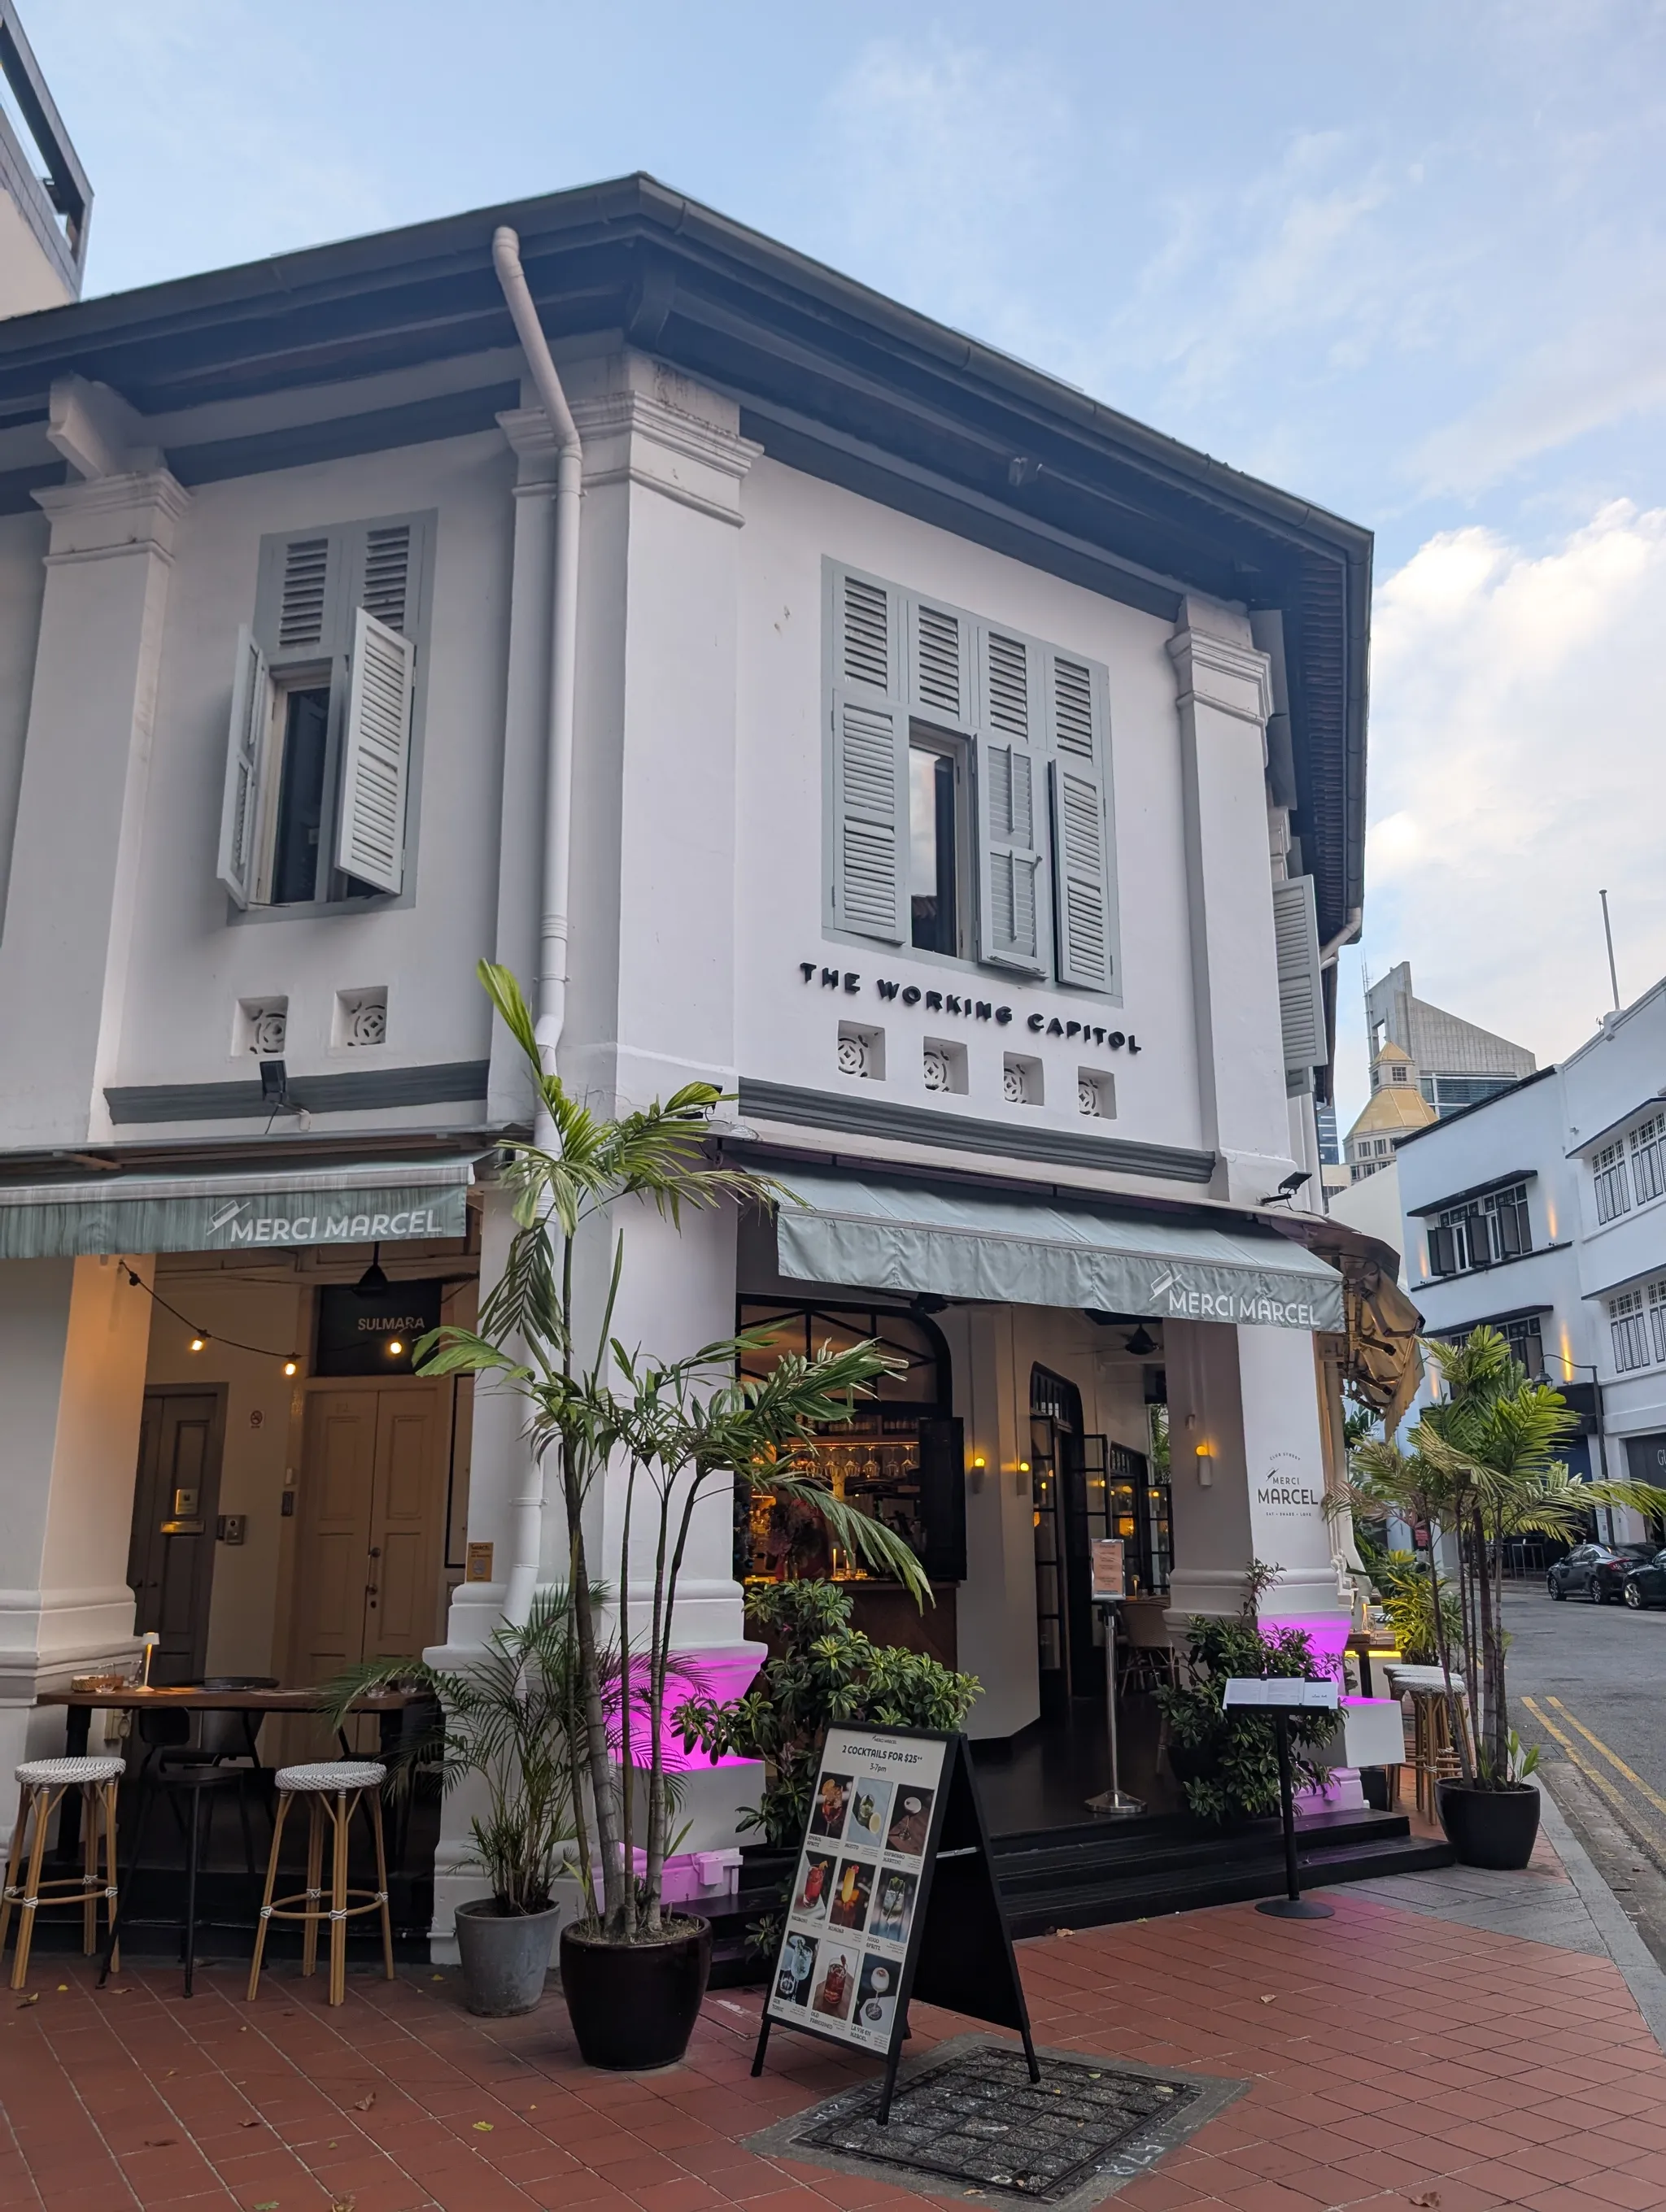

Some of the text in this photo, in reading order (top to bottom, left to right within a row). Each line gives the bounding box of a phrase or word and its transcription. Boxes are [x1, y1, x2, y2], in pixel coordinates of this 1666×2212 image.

[800, 962, 1142, 1054] THE WORKING CAPITOL
[230, 1209, 443, 1242] MERCI MARCEL
[1169, 1290, 1321, 1326] MERCI MARCEL
[358, 1317, 425, 1330] SULMARA
[1272, 1477, 1300, 1485] MERCI
[1258, 1488, 1319, 1505] MARCEL
[842, 1744, 847, 1753] 2
[848, 1746, 888, 1759] COCKTAILS
[888, 1752, 903, 1762] FOR
[870, 1762, 887, 1773] 3-7pm
